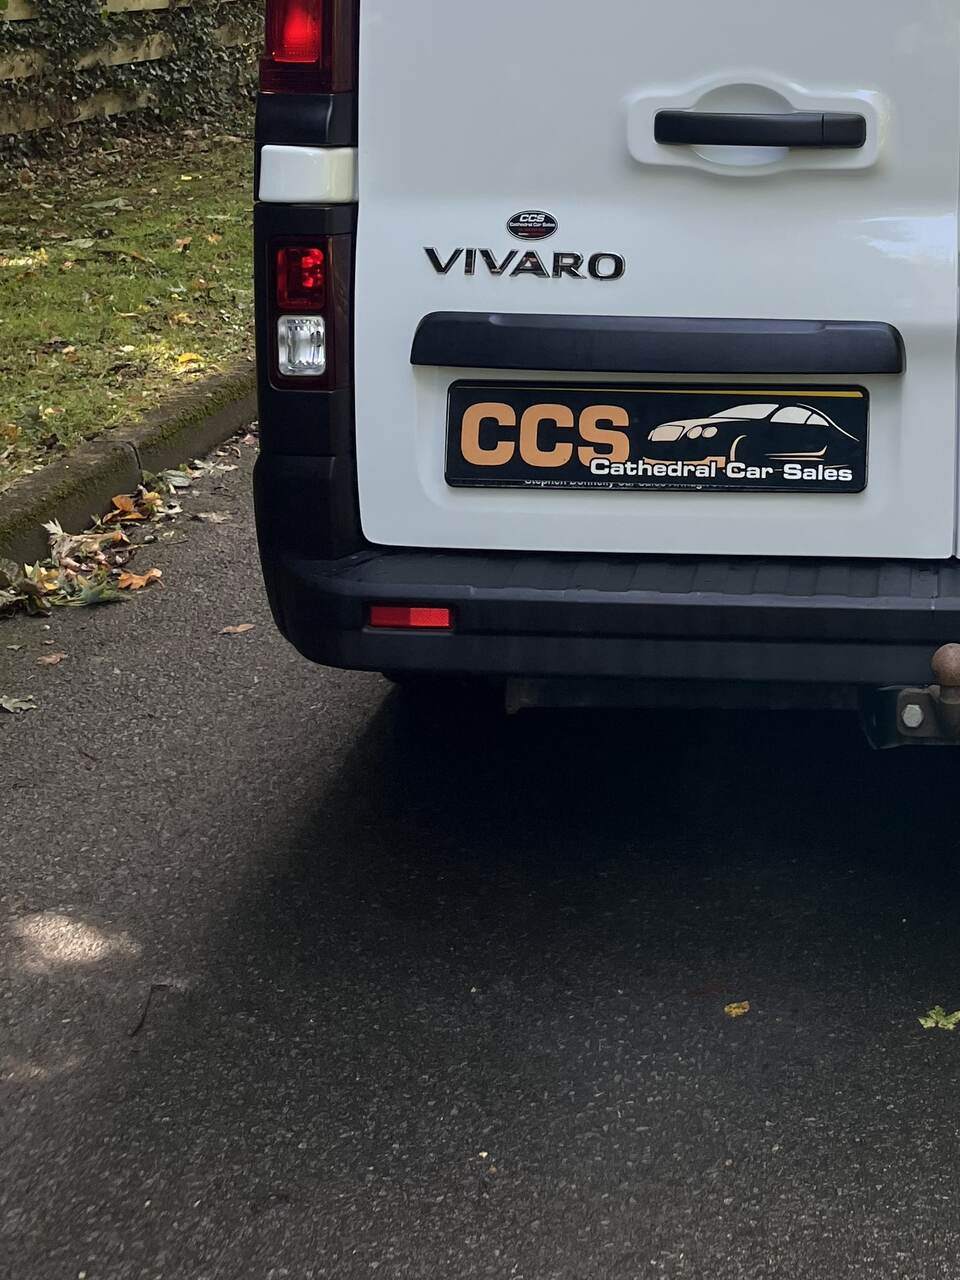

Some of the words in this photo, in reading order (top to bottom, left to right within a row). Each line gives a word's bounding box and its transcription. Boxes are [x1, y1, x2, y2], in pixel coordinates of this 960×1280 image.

[520, 214, 545, 222] CCS
[423, 247, 626, 281] VIVARO
[460, 402, 630, 468] CCS
[590, 458, 716, 478] Cathedral
[725, 462, 773, 479] Car
[783, 463, 852, 482] Sales
